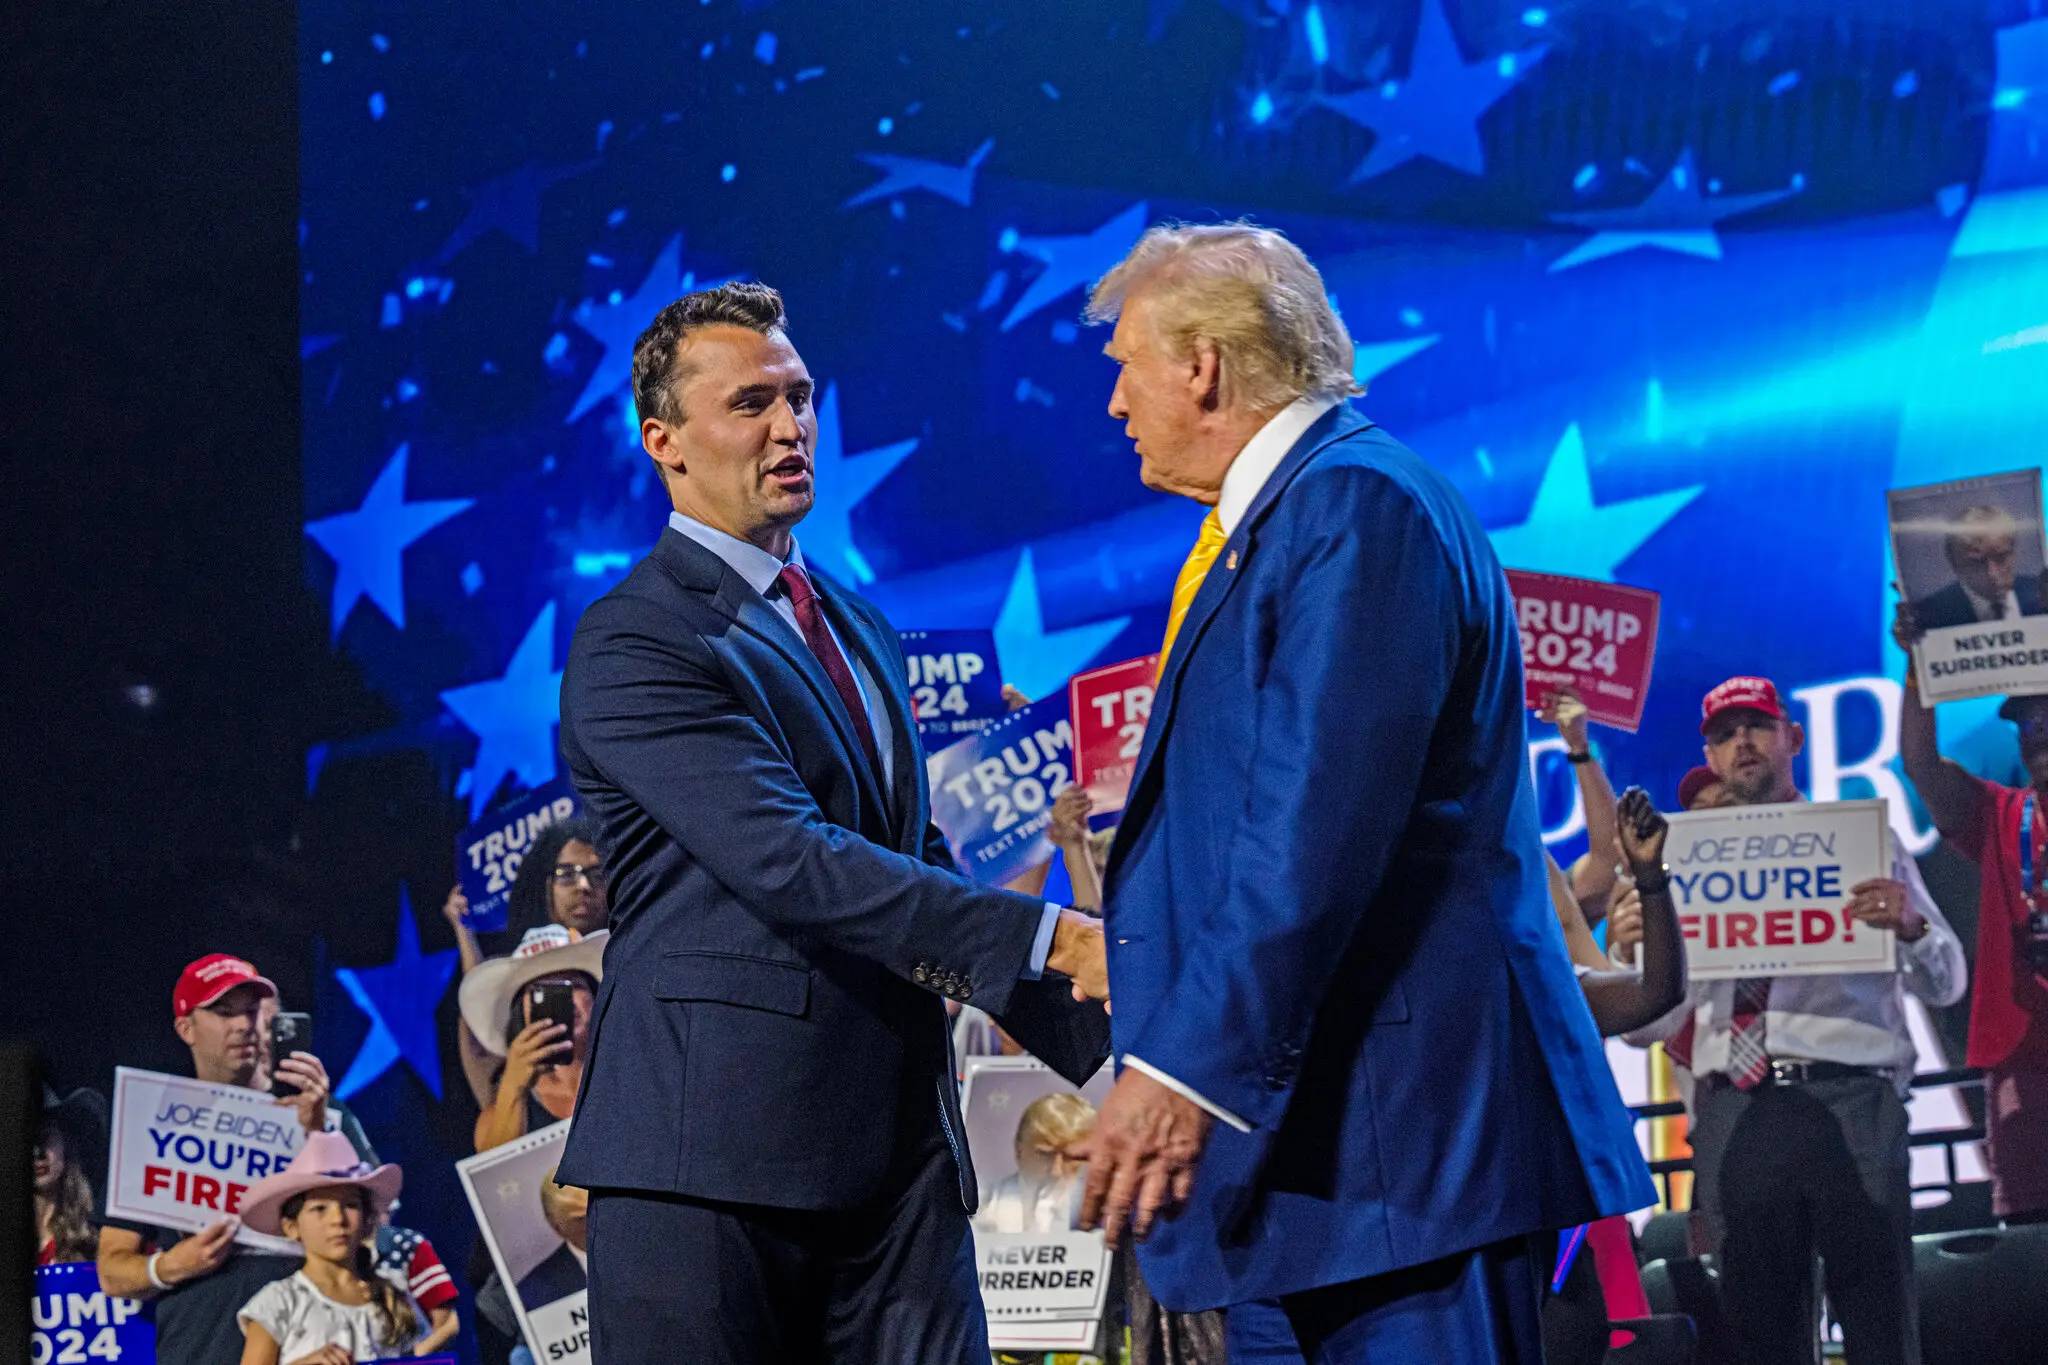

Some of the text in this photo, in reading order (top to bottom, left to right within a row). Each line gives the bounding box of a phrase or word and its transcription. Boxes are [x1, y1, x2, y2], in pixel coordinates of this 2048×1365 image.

[1514, 596, 1642, 645] RUMP
[1954, 629, 2025, 652] NEVER
[1519, 630, 1619, 676] 2024
[914, 684, 969, 718] 24
[1091, 685, 1154, 729] TR
[467, 797, 574, 870] TRUMP
[1678, 837, 1740, 865] JOE
[1672, 864, 1842, 904] YOU'RE
[1679, 905, 1856, 949] FIRED!
[155, 1103, 213, 1130] JOE
[148, 1127, 292, 1178] YOU'RE
[143, 1165, 249, 1214] FIRE
[987, 1245, 1067, 1266] NEVER
[31, 1292, 142, 1329] UMP
